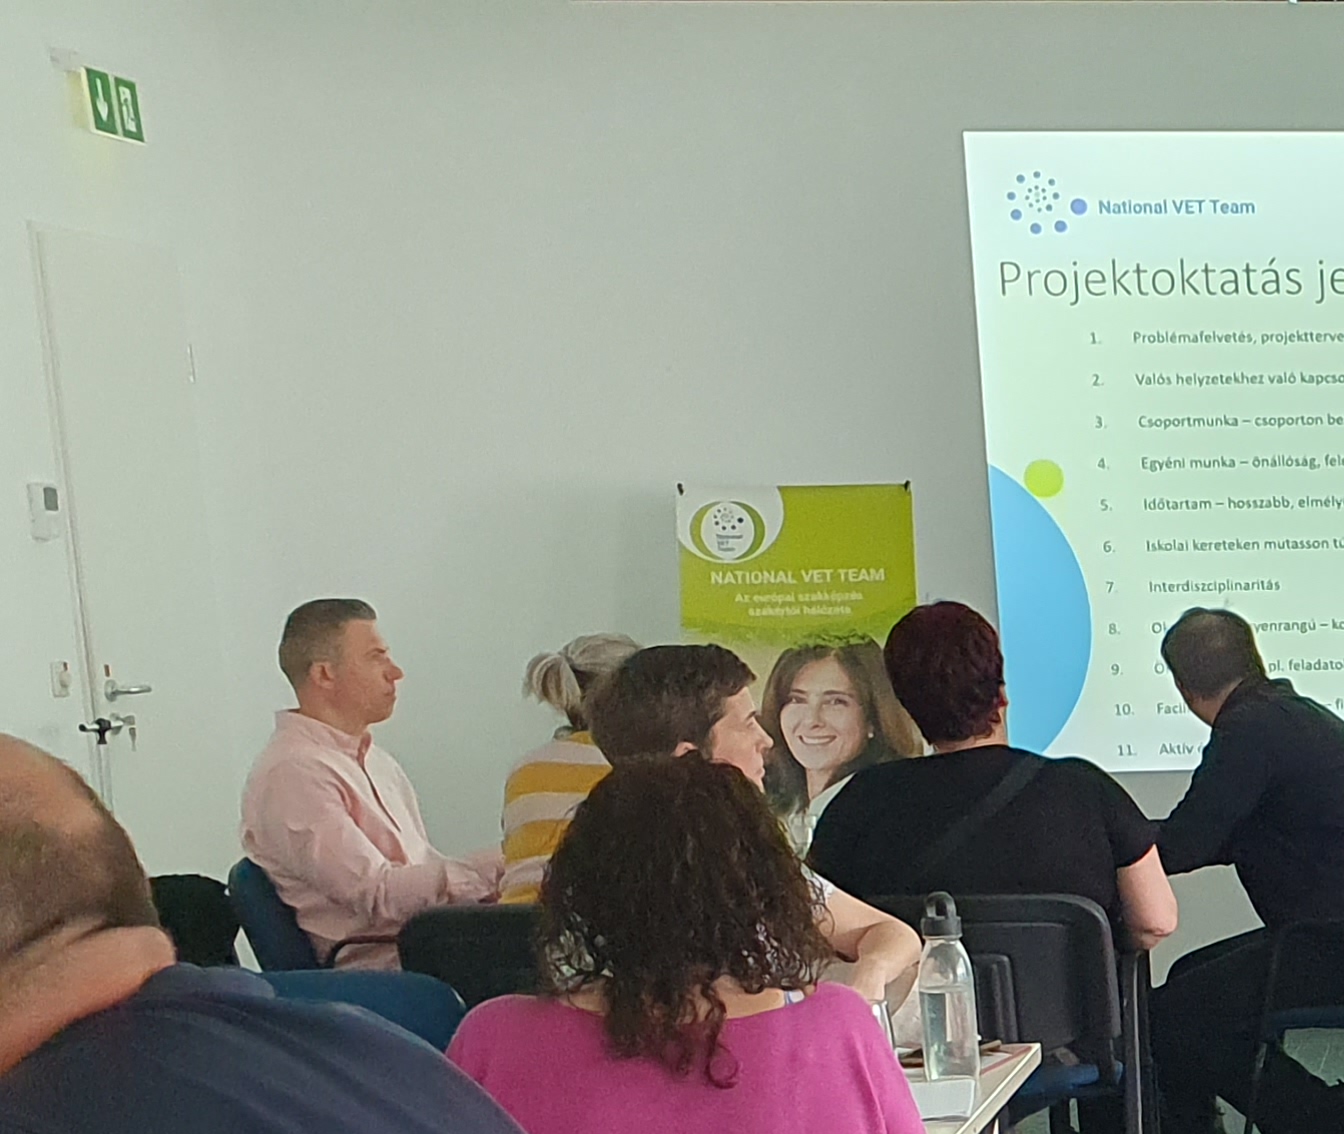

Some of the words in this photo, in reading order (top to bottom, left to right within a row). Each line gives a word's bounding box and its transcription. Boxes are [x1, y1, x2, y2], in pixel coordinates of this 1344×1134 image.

[1099, 199, 1167, 214] National
[1172, 200, 1205, 214] VET
[1209, 200, 1255, 214] Team
[1000, 257, 1302, 306] Projektoktatás
[1091, 332, 1101, 344] 1.
[1133, 330, 1256, 344] Problémafelvetés,
[1093, 374, 1104, 386] 2.
[1135, 373, 1172, 385] Valós
[1176, 372, 1264, 387] helyzetekhez
[1268, 372, 1296, 384] való
[1095, 416, 1107, 428] 3.
[1139, 414, 1238, 430] Csoportmunka
[1255, 416, 1323, 428] csoporton
[1098, 458, 1109, 469] 4.
[1142, 457, 1185, 472] Egyéni
[1190, 456, 1235, 468] munka
[1252, 455, 1320, 470] önállóság,
[1100, 499, 1112, 511] 5.
[1144, 498, 1212, 510] Időtartam
[1228, 496, 1294, 509] hosszabb,
[1103, 541, 1115, 553] 6.
[1146, 539, 1188, 552] Iskolai
[1193, 538, 1259, 551] kereteken
[1264, 539, 1329, 549] mutasson
[711, 570, 797, 585] NATIONAL
[801, 569, 833, 583] VET
[838, 568, 885, 583] TEAM
[1149, 579, 1280, 594] Interdiszciplinaritás
[1109, 623, 1120, 635] 8.
[1255, 619, 1316, 634] yenrangú
[1111, 664, 1123, 675] 9.
[1268, 660, 1284, 674] pl.
[1115, 704, 1134, 716] 10.
[1118, 745, 1136, 756] 11.
[1160, 743, 1194, 755] Aktív
